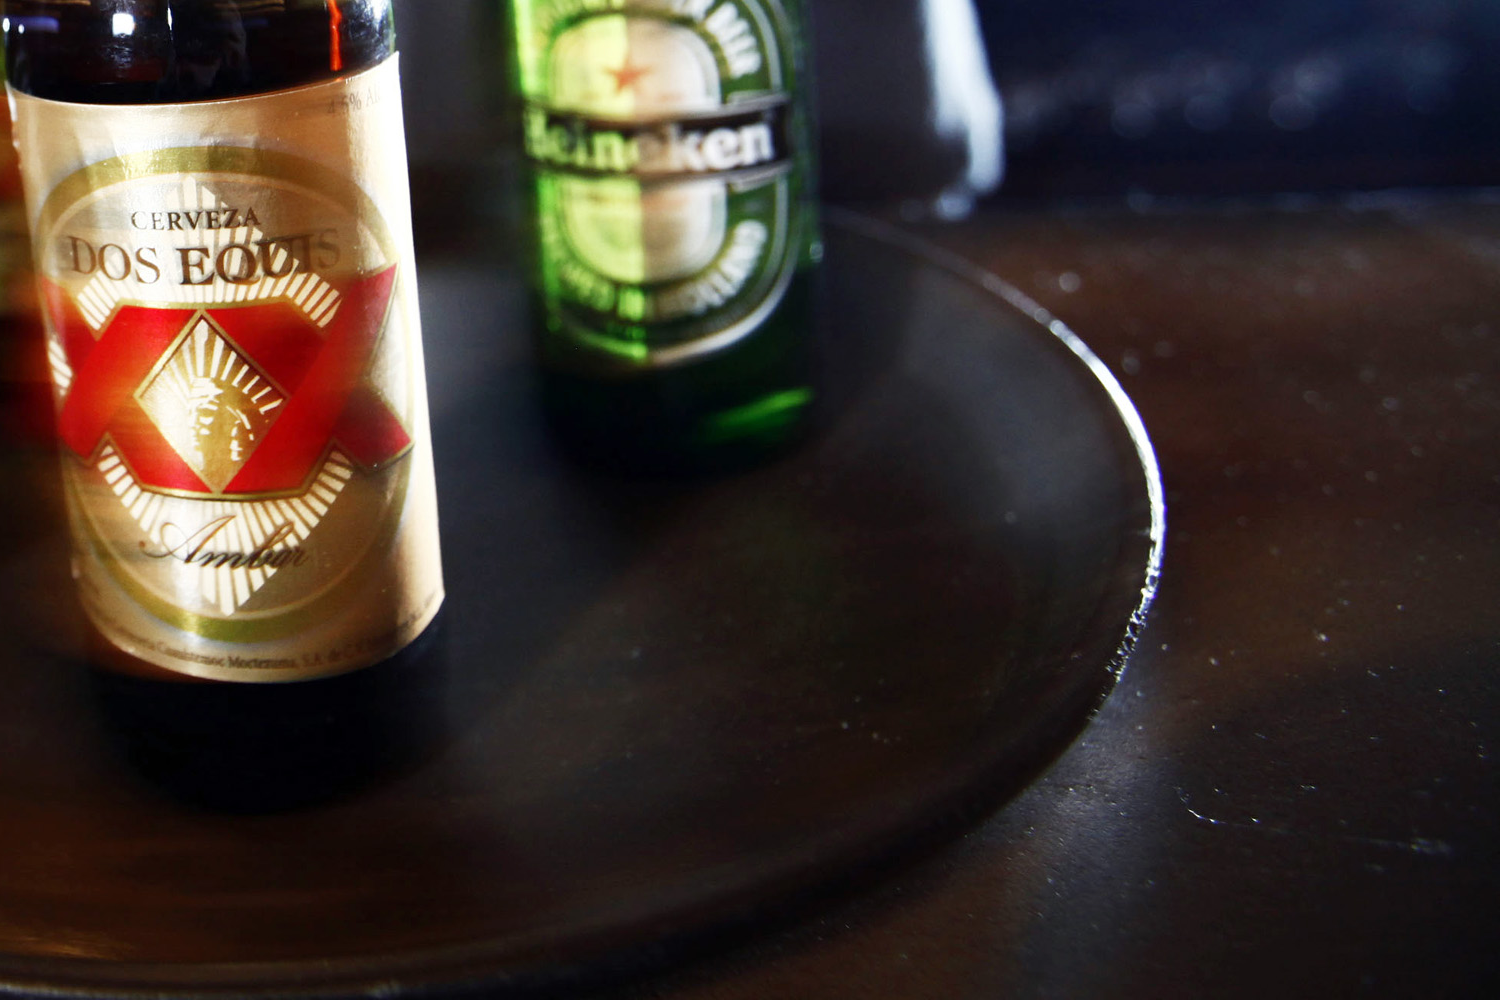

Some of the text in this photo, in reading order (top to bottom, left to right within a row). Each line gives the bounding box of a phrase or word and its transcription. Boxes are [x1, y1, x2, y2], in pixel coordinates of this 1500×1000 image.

[130, 206, 262, 231] CERVEZA
[67, 228, 342, 286] DOS EQUIS
